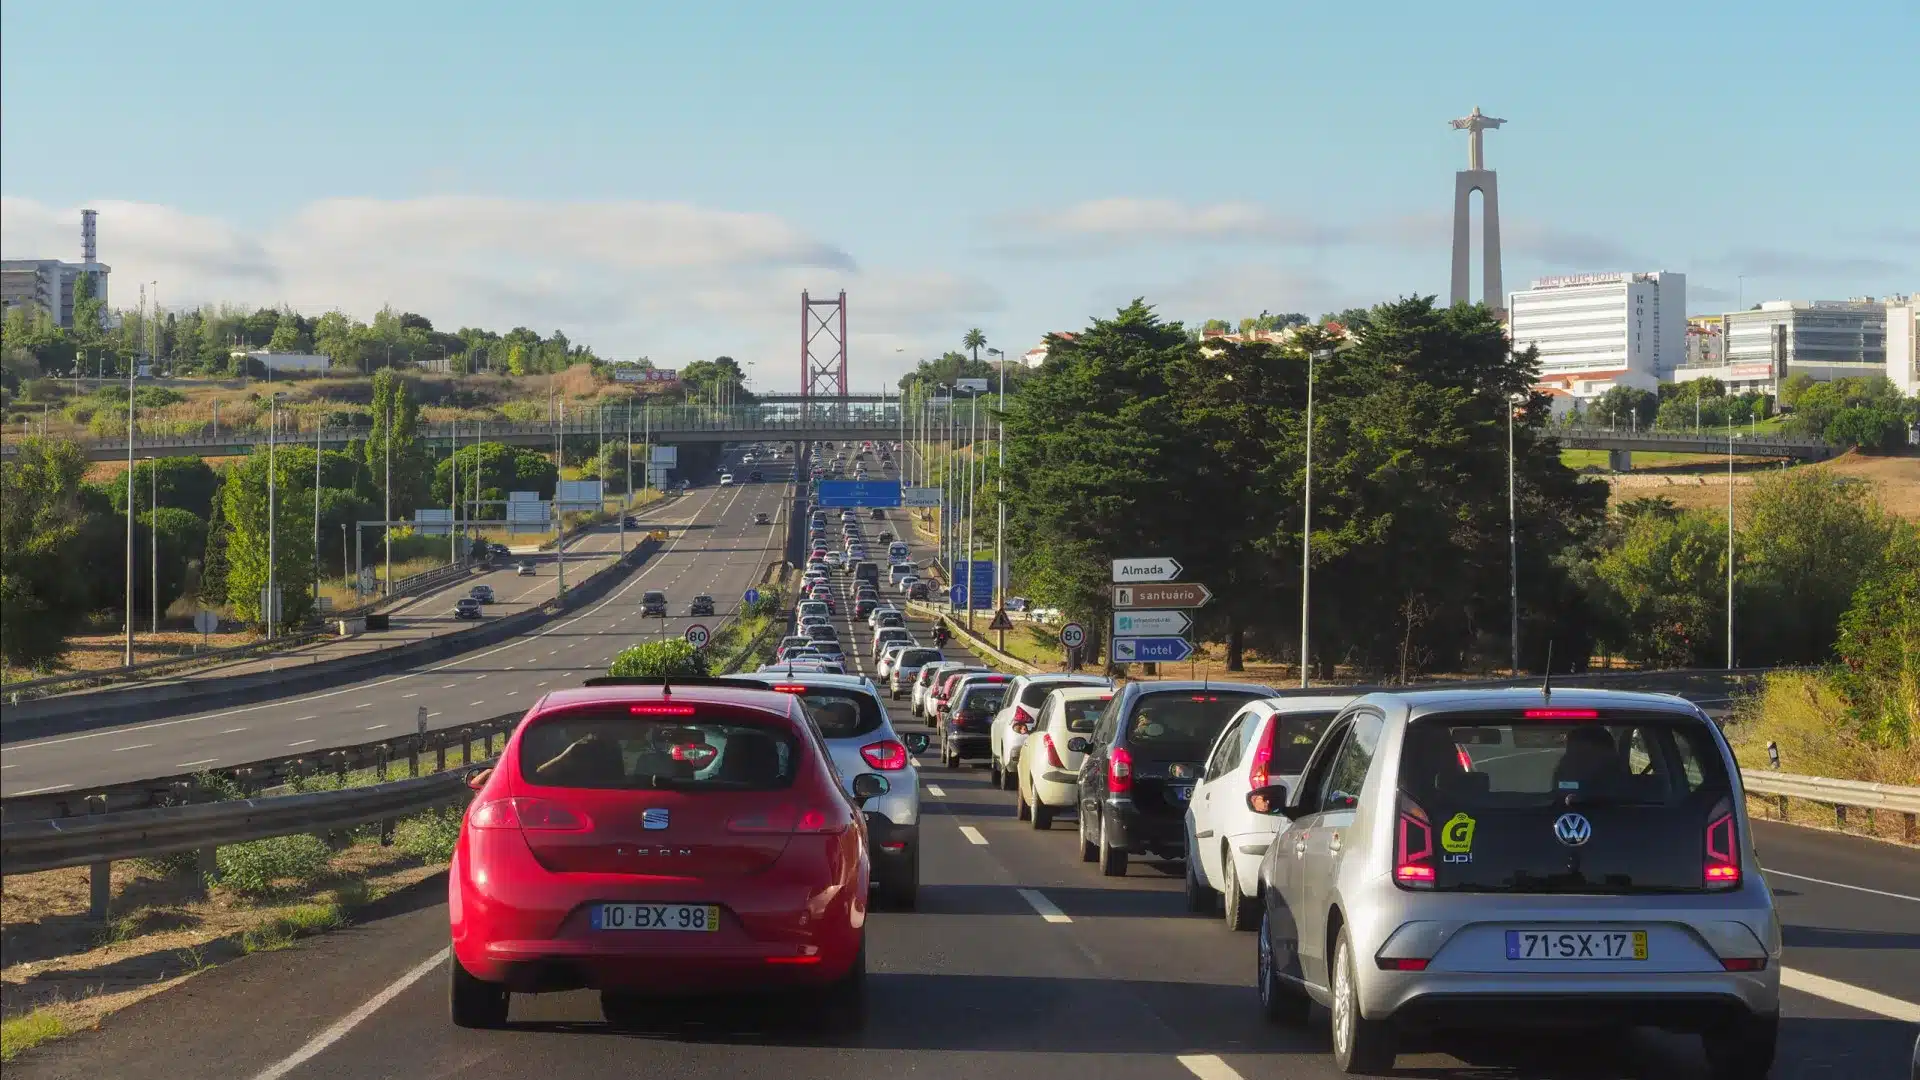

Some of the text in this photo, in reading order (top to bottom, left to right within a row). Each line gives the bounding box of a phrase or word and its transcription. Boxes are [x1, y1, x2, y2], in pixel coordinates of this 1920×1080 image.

[1121, 565, 1164, 576] Almada
[1139, 590, 1195, 600] santuário
[690, 631, 706, 642] 80
[1065, 630, 1081, 641] 80
[1142, 644, 1173, 655] hotel
[1443, 852, 1473, 865] up!
